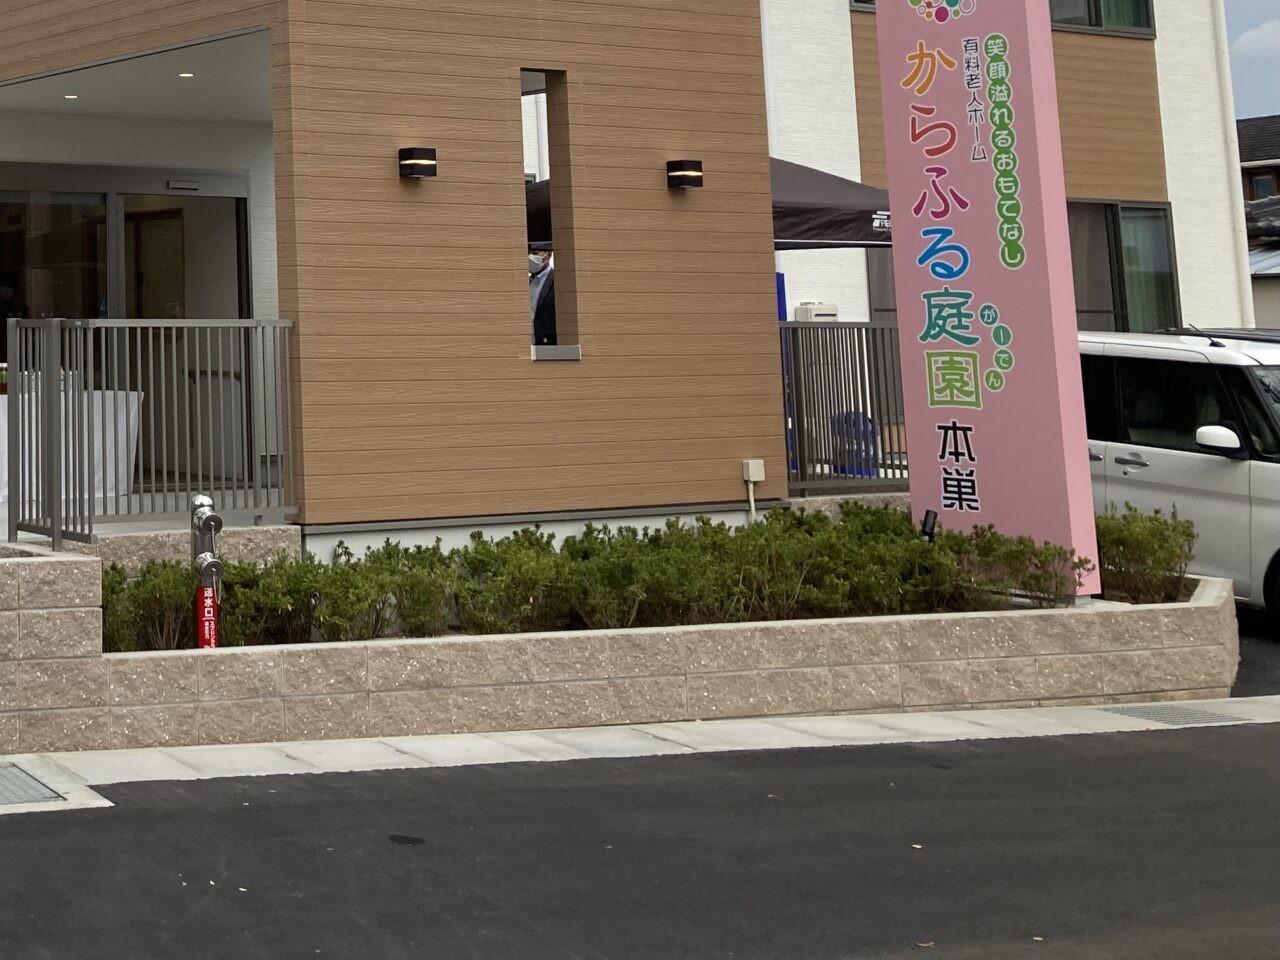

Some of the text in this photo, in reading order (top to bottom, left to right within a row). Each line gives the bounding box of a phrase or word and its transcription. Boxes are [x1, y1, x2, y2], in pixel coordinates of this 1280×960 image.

[962, 38, 987, 161] 有料老人ホーム
[986, 38, 1021, 264] 笑顔溢れるおもてなし
[981, 305, 1011, 389] がーでん
[204, 587, 213, 617] 送水口
